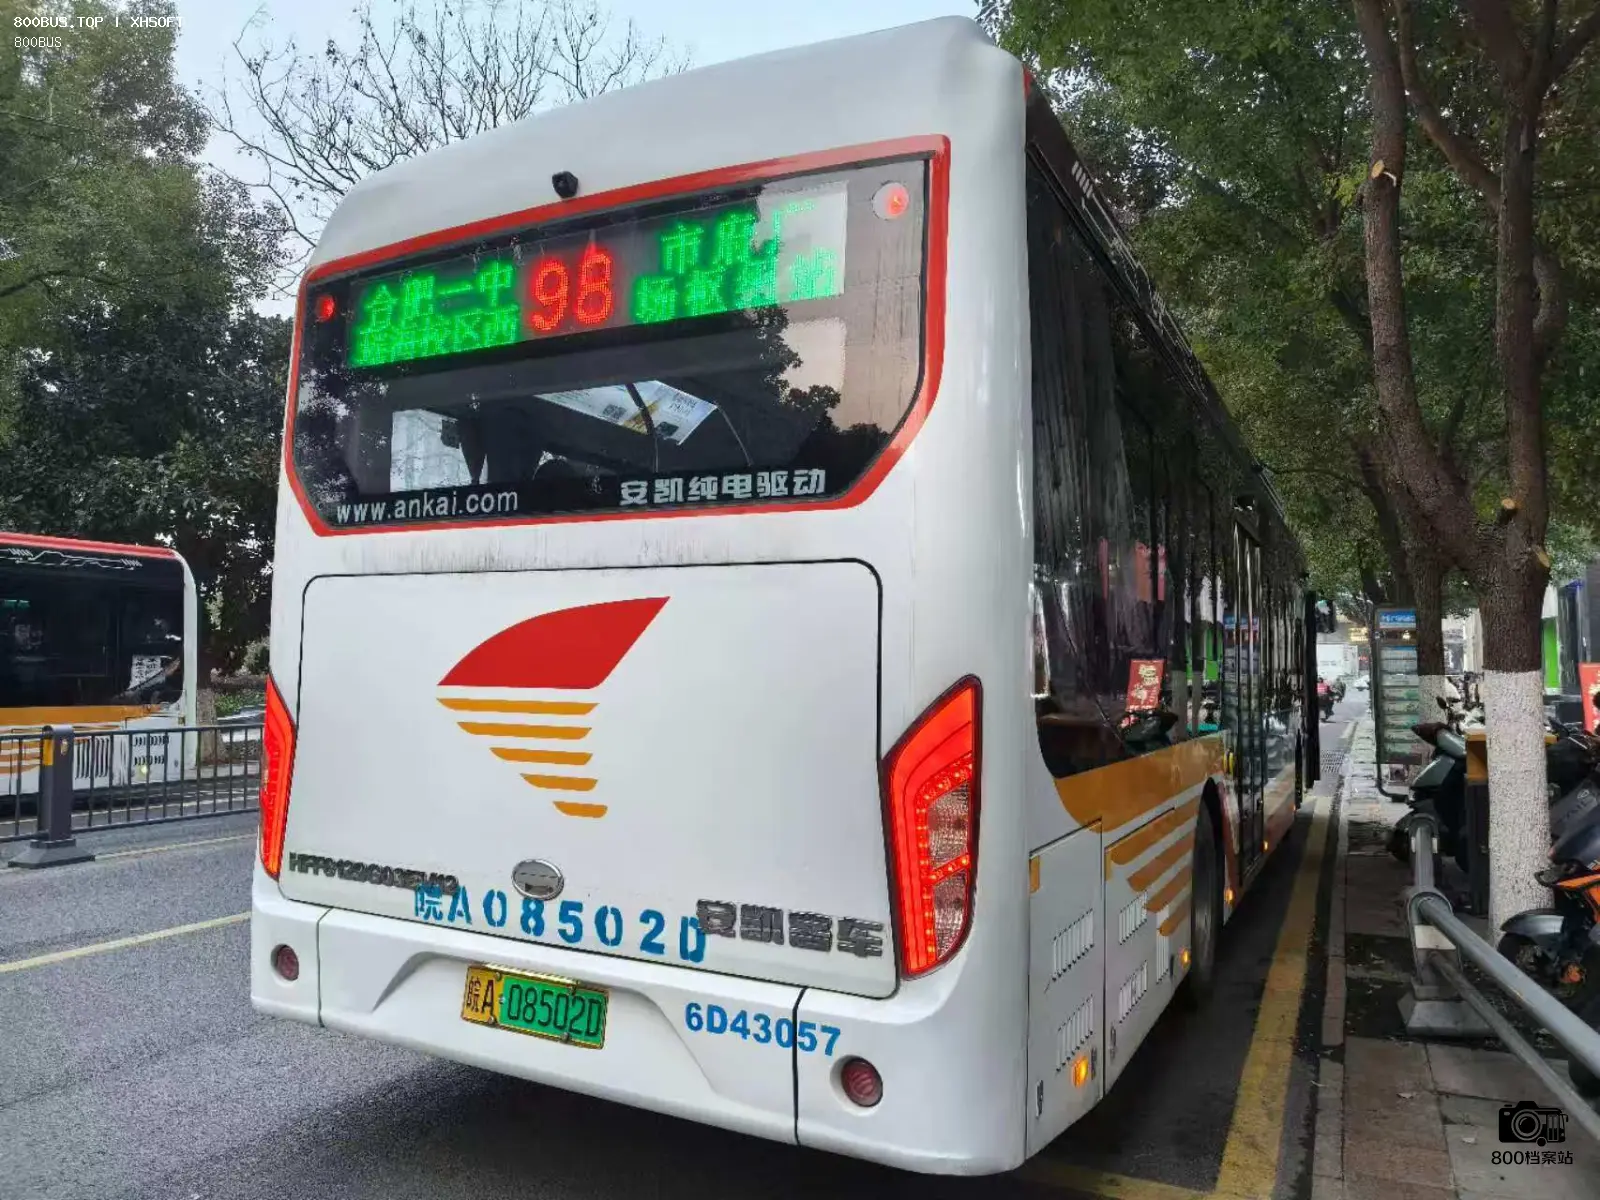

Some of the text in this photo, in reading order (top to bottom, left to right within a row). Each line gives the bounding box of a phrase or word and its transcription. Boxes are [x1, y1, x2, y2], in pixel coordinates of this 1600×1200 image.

[363, 260, 515, 332] 合肥一中
[532, 250, 613, 331] 98
[336, 490, 519, 524] www.ankai.com
[619, 468, 827, 506] 安凯纯电驱动
[696, 898, 885, 958] 安凯客车
[684, 1001, 842, 1057] 6D43057
